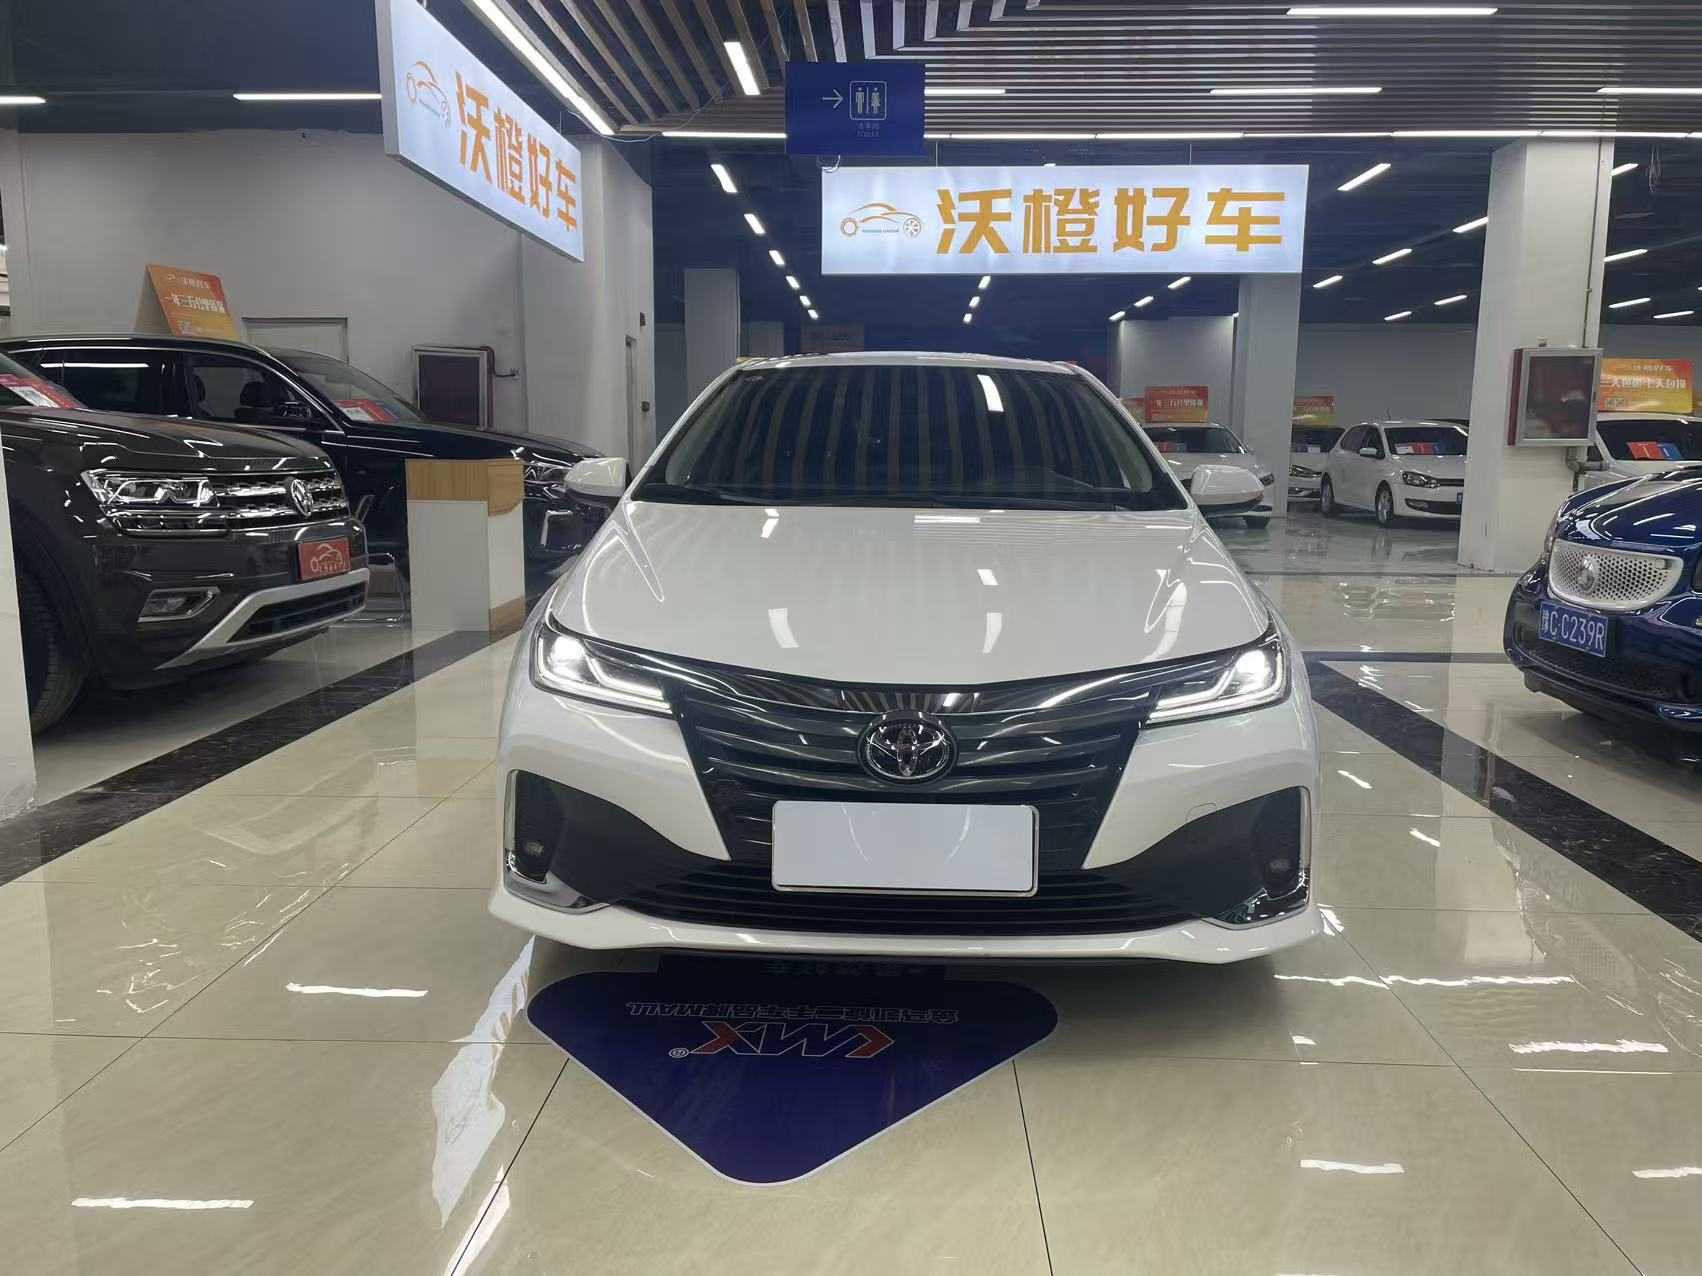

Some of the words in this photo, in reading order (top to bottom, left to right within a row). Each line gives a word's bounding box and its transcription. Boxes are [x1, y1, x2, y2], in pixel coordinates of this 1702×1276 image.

[454, 71, 578, 231] 沃橙好车
[936, 187, 1286, 255] 沃橙好车
